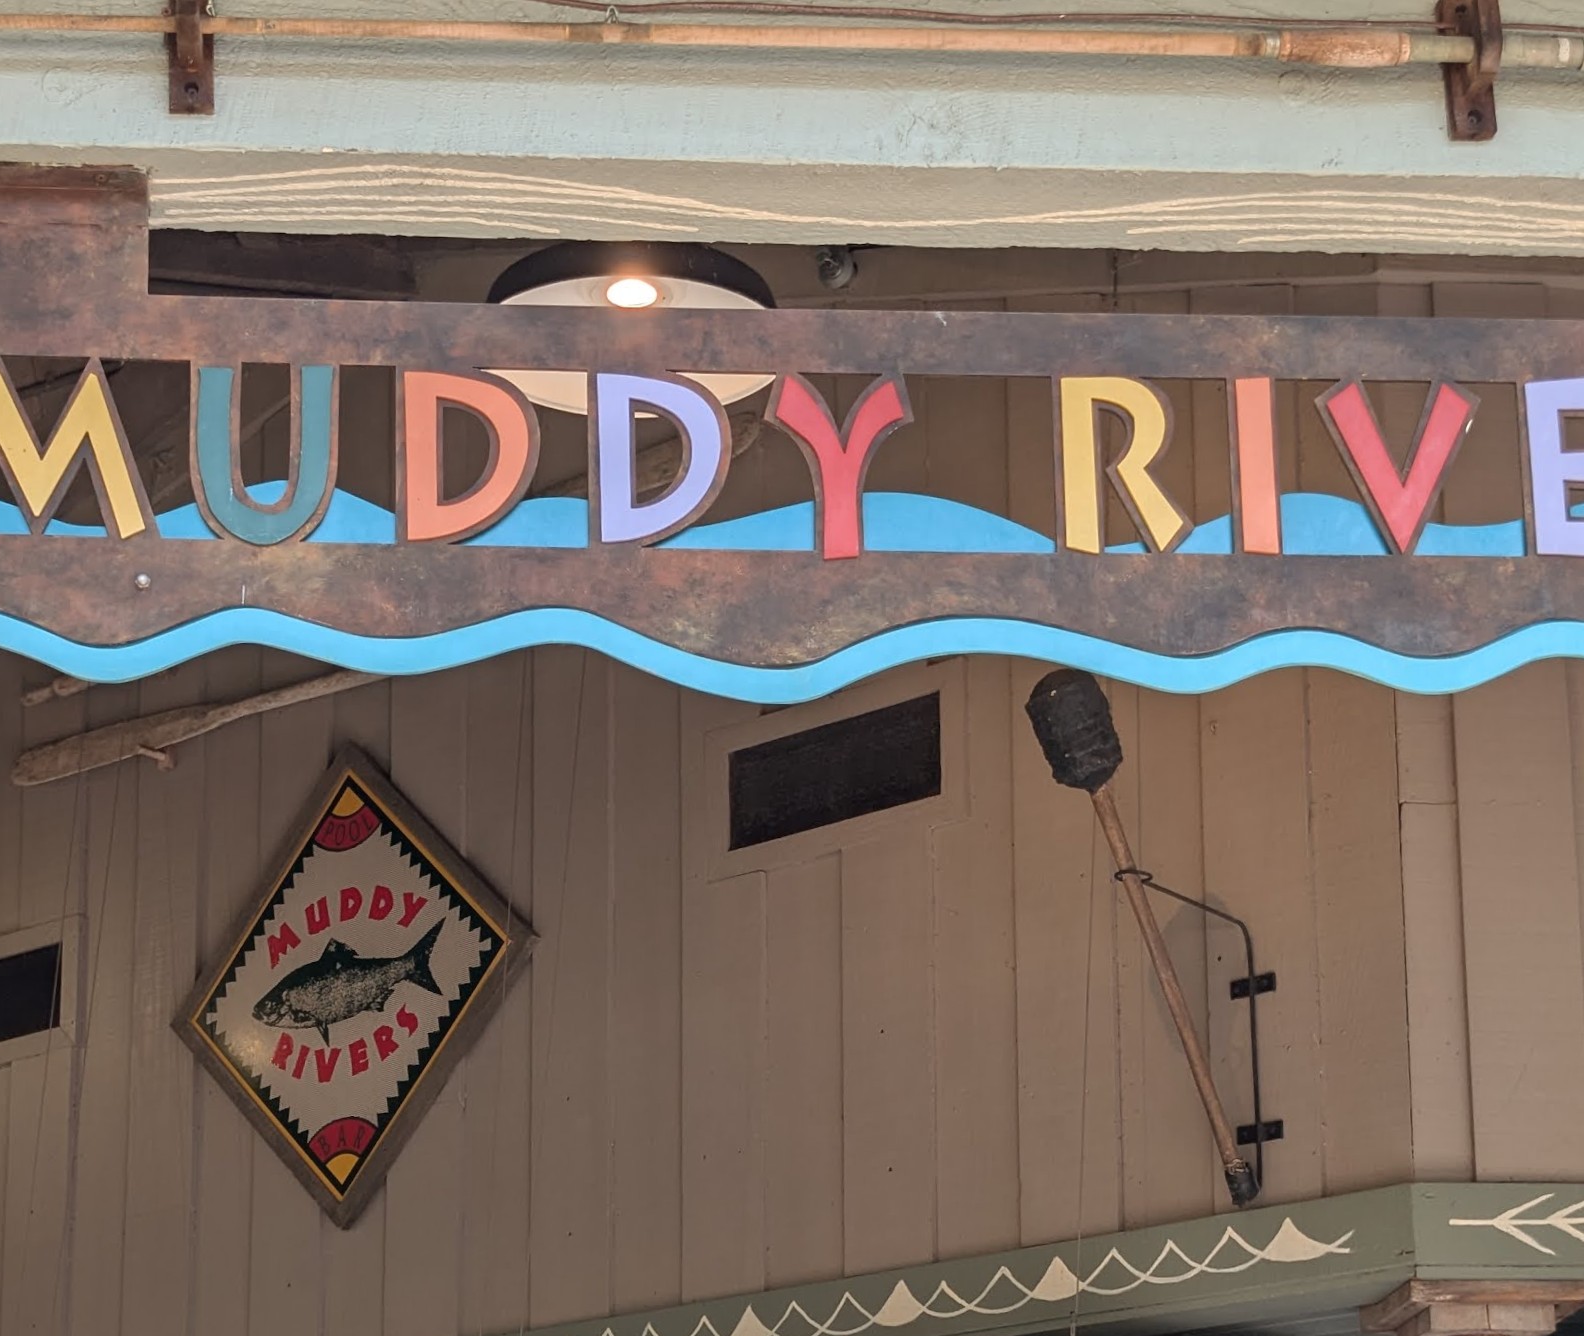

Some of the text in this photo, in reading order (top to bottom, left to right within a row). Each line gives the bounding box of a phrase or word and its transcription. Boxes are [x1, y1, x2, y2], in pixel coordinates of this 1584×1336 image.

[323, 814, 374, 846] POOL
[266, 885, 427, 969] MUDDY
[270, 1003, 419, 1083] RIVERS
[317, 1123, 366, 1152] BAR
